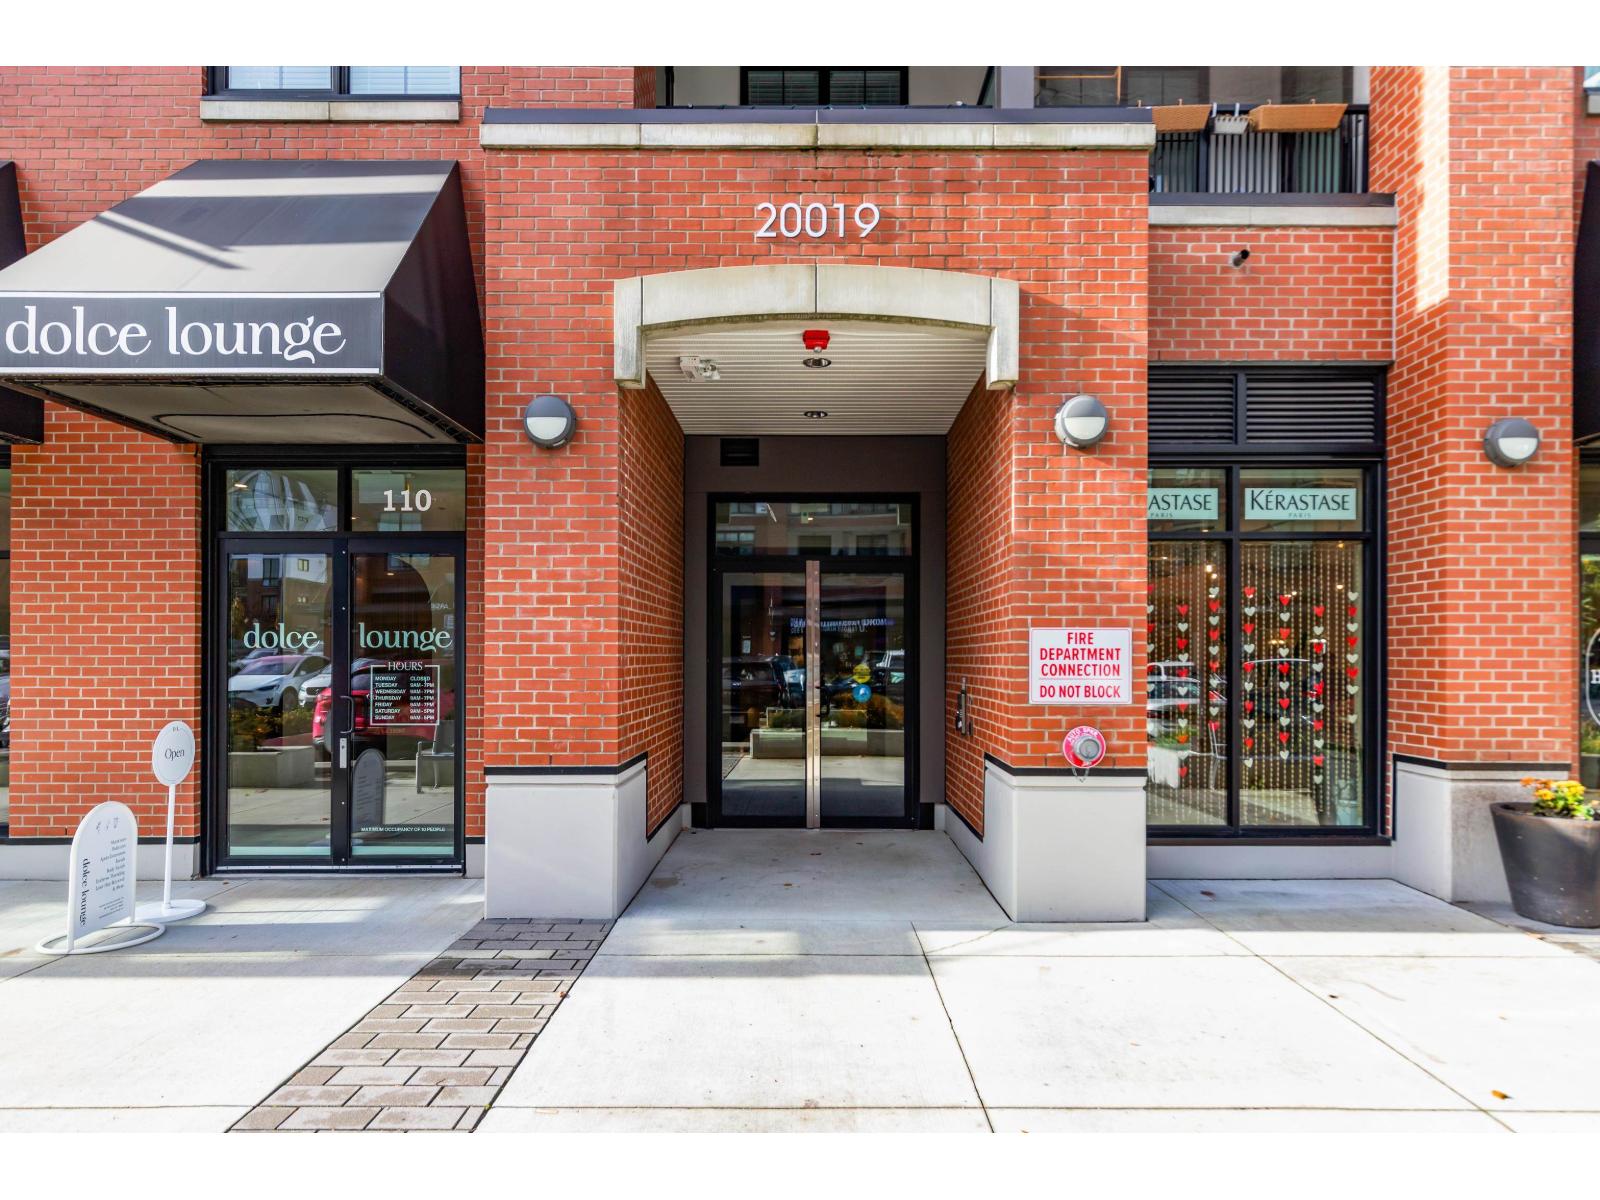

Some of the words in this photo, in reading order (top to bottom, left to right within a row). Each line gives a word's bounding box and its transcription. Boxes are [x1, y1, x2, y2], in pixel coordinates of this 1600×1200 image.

[755, 202, 880, 239] 20019
[5, 305, 152, 356] dolce
[164, 306, 347, 364] lounge
[383, 489, 432, 513] 110
[1250, 489, 1350, 511] KÉRASTASE
[243, 622, 320, 649] dolce
[358, 622, 453, 652] lounge
[1066, 632, 1094, 645] FIRE
[1039, 647, 1121, 661] DEPARTMENT
[387, 661, 423, 671] HOURS
[1041, 663, 1121, 677] CONNECTION
[1039, 685, 1056, 698] DO
[1058, 685, 1081, 698] NOT
[1084, 685, 1121, 698] BLOCK
[164, 748, 185, 761] Open
[81, 857, 91, 888] dolce
[79, 889, 90, 928] lounge
